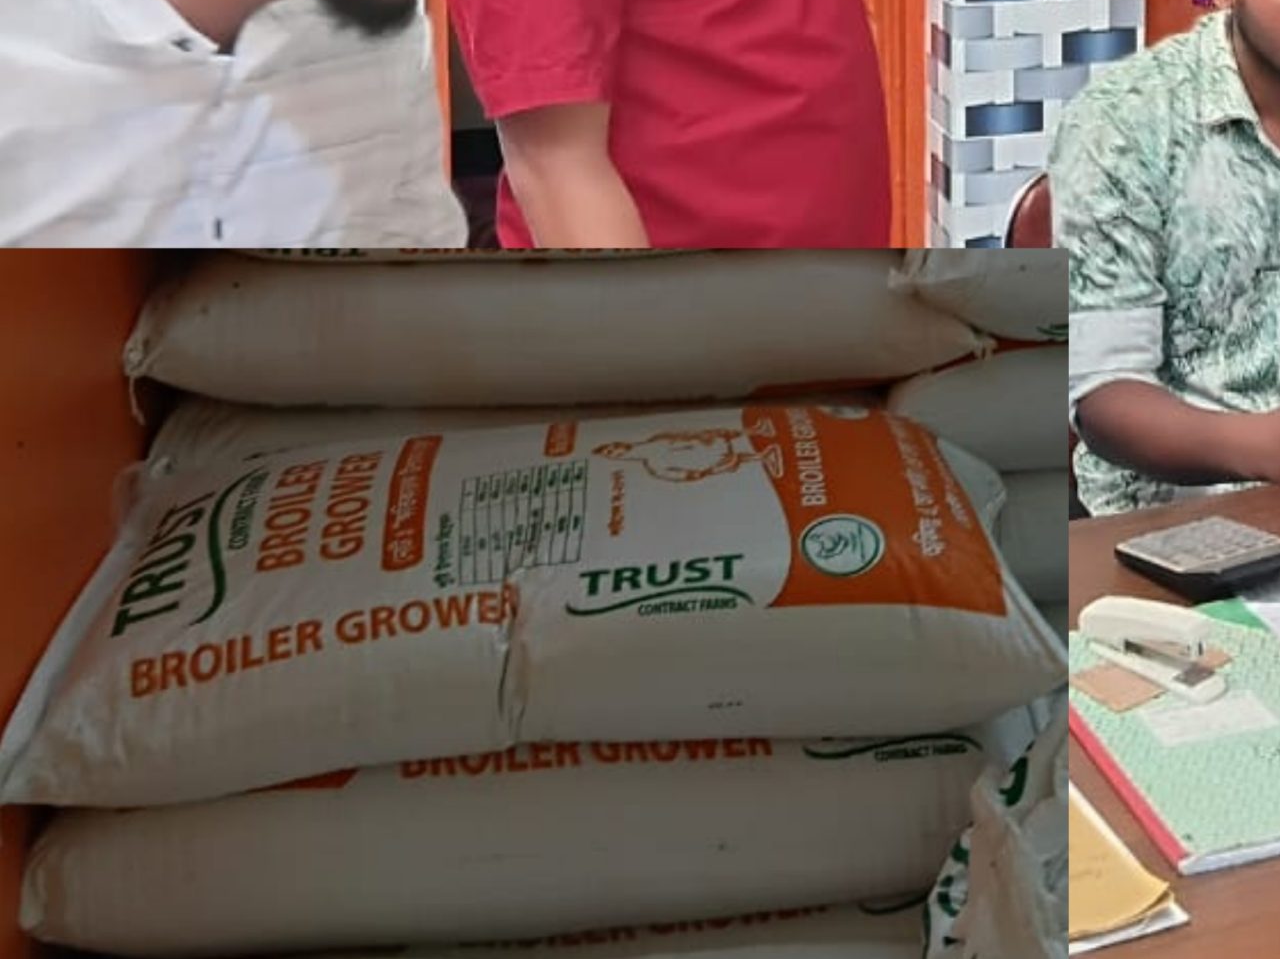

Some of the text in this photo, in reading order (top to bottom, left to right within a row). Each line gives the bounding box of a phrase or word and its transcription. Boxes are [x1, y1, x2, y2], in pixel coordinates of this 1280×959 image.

[256, 459, 329, 572] BROILER
[320, 450, 384, 560] GROWER
[794, 440, 828, 507] BROILER
[111, 492, 216, 637] TRUST
[578, 553, 744, 597] TRUST
[638, 600, 698, 617] CONTRACT
[130, 581, 521, 699] BROILER GROWER
